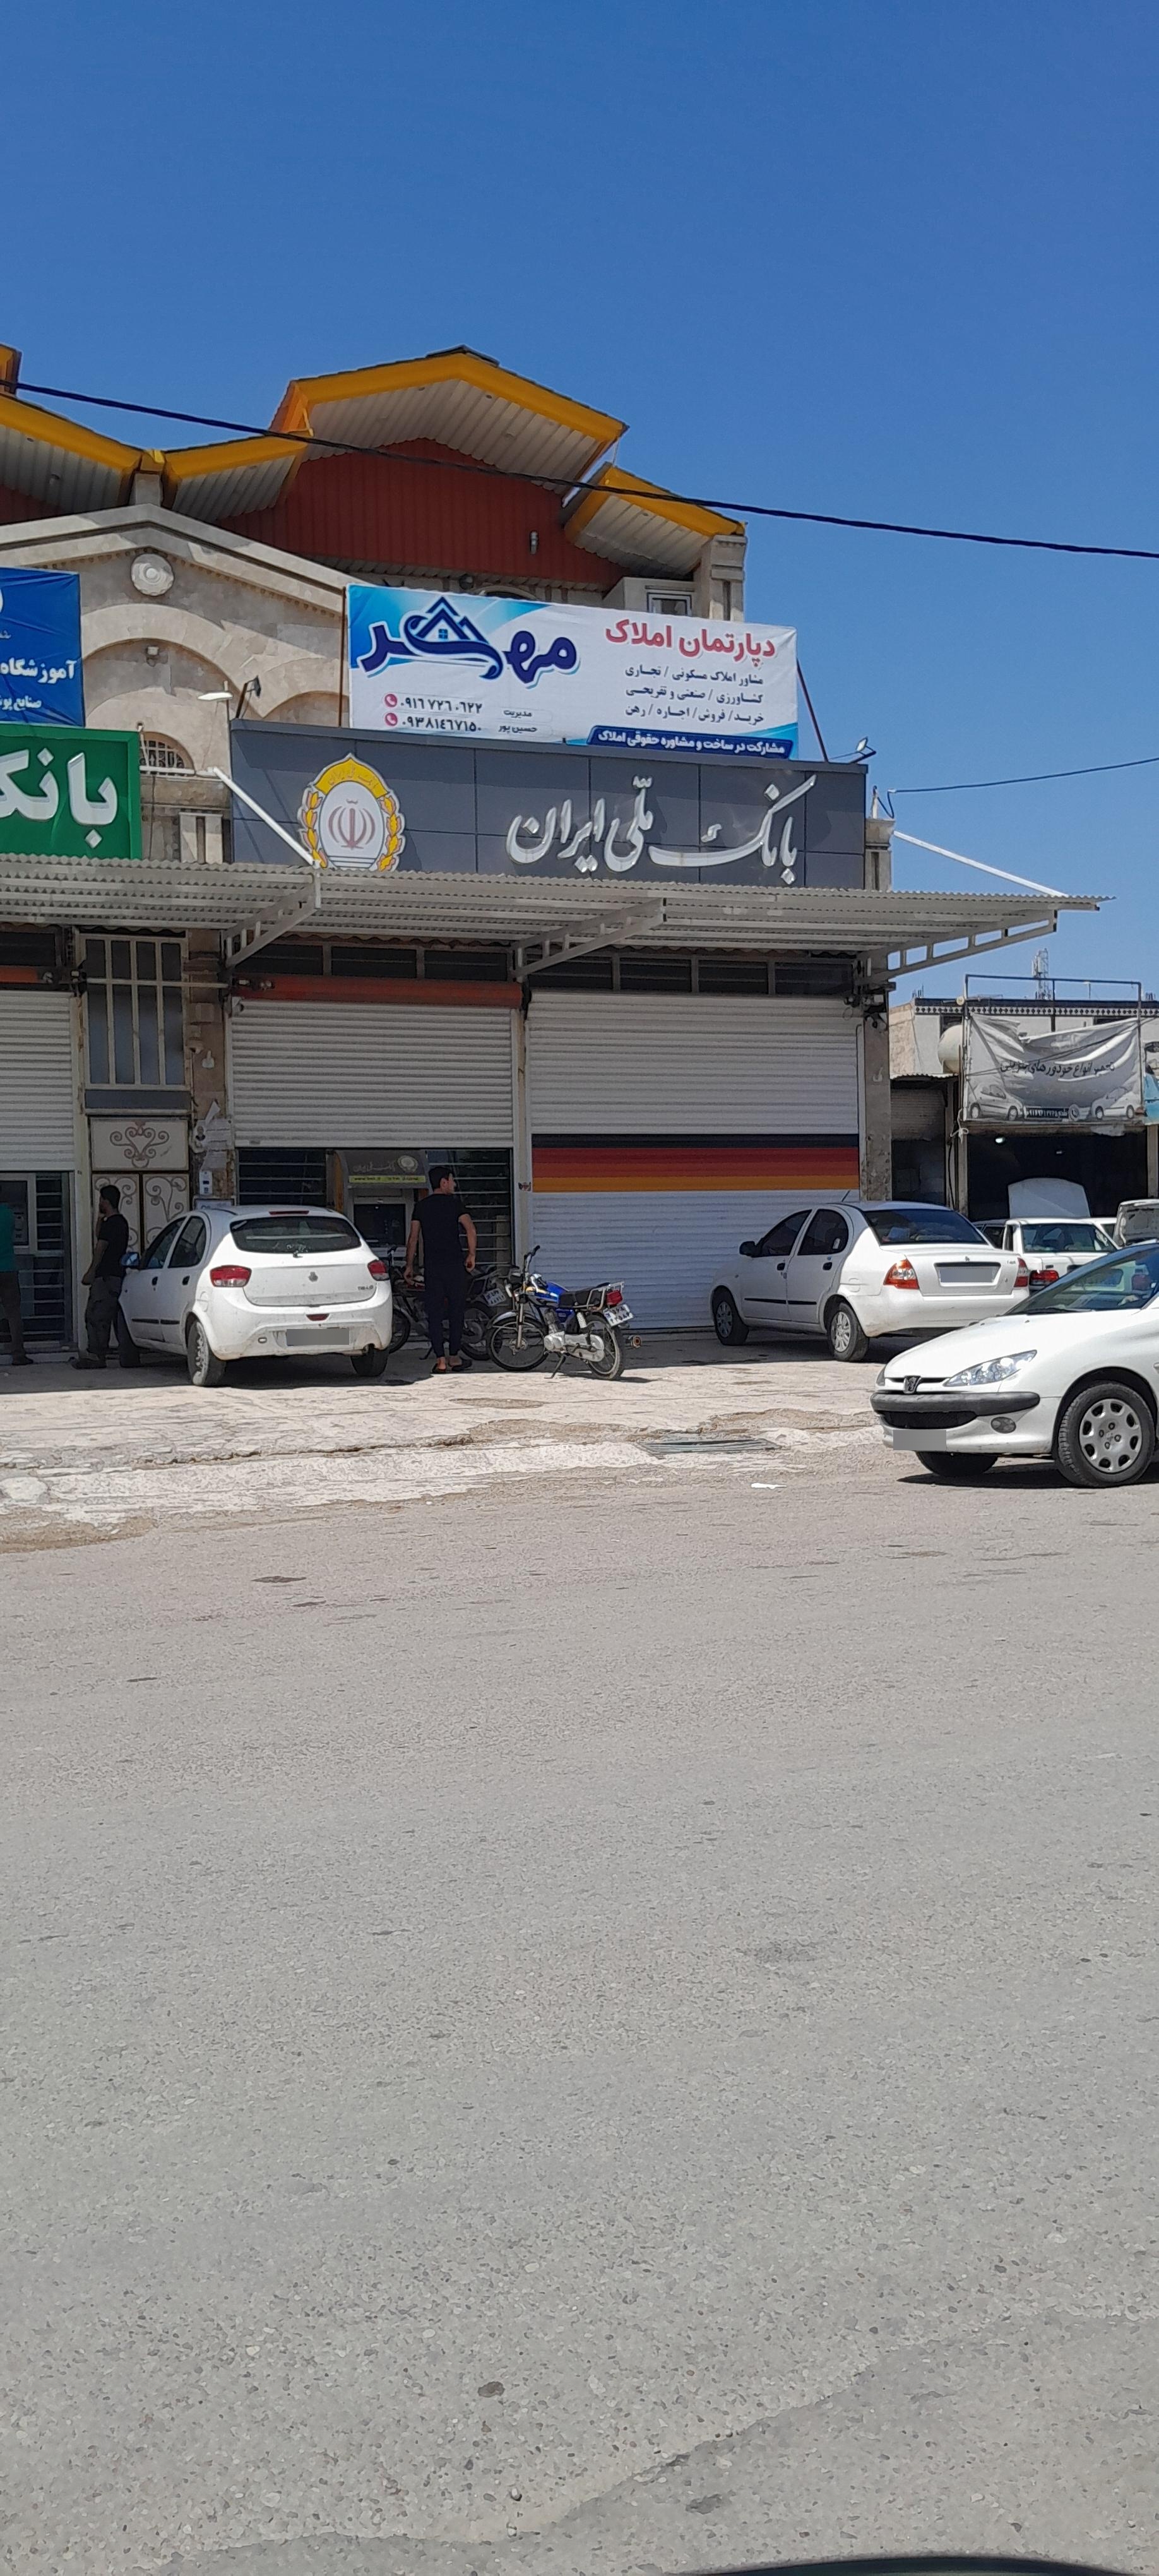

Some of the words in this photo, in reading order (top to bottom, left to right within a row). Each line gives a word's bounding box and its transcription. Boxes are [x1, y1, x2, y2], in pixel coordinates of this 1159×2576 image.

[605, 618, 672, 648] املاک
[679, 628, 775, 667] دپارتمان
[0, 657, 76, 684] آموزشگاه
[625, 664, 662, 678] تجاری
[672, 667, 708, 682] مسکونی
[710, 671, 736, 683] املاک
[739, 674, 763, 687] مشاور
[626, 686, 667, 699] تفریحی
[669, 691, 674, 700] و
[677, 689, 706, 700] صنعتی
[716, 692, 764, 705] کشاورزی
[503, 708, 532, 719] مدیریت
[625, 705, 646, 717] رهن
[657, 705, 690, 720] اجاره
[497, 725, 511, 734] پور
[512, 725, 538, 734] حسین
[598, 730, 626, 742] املاک
[626, 729, 660, 746] حقوقی
[662, 735, 694, 749] مشاوره
[703, 738, 733, 750] ساخت
[695, 740, 702, 751] و
[734, 743, 746, 754] در
[747, 741, 785, 756] مشارکت
[506, 797, 605, 873] ایران
[648, 774, 817, 885] بانک
[1073, 1062, 1093, 1078] انواع
